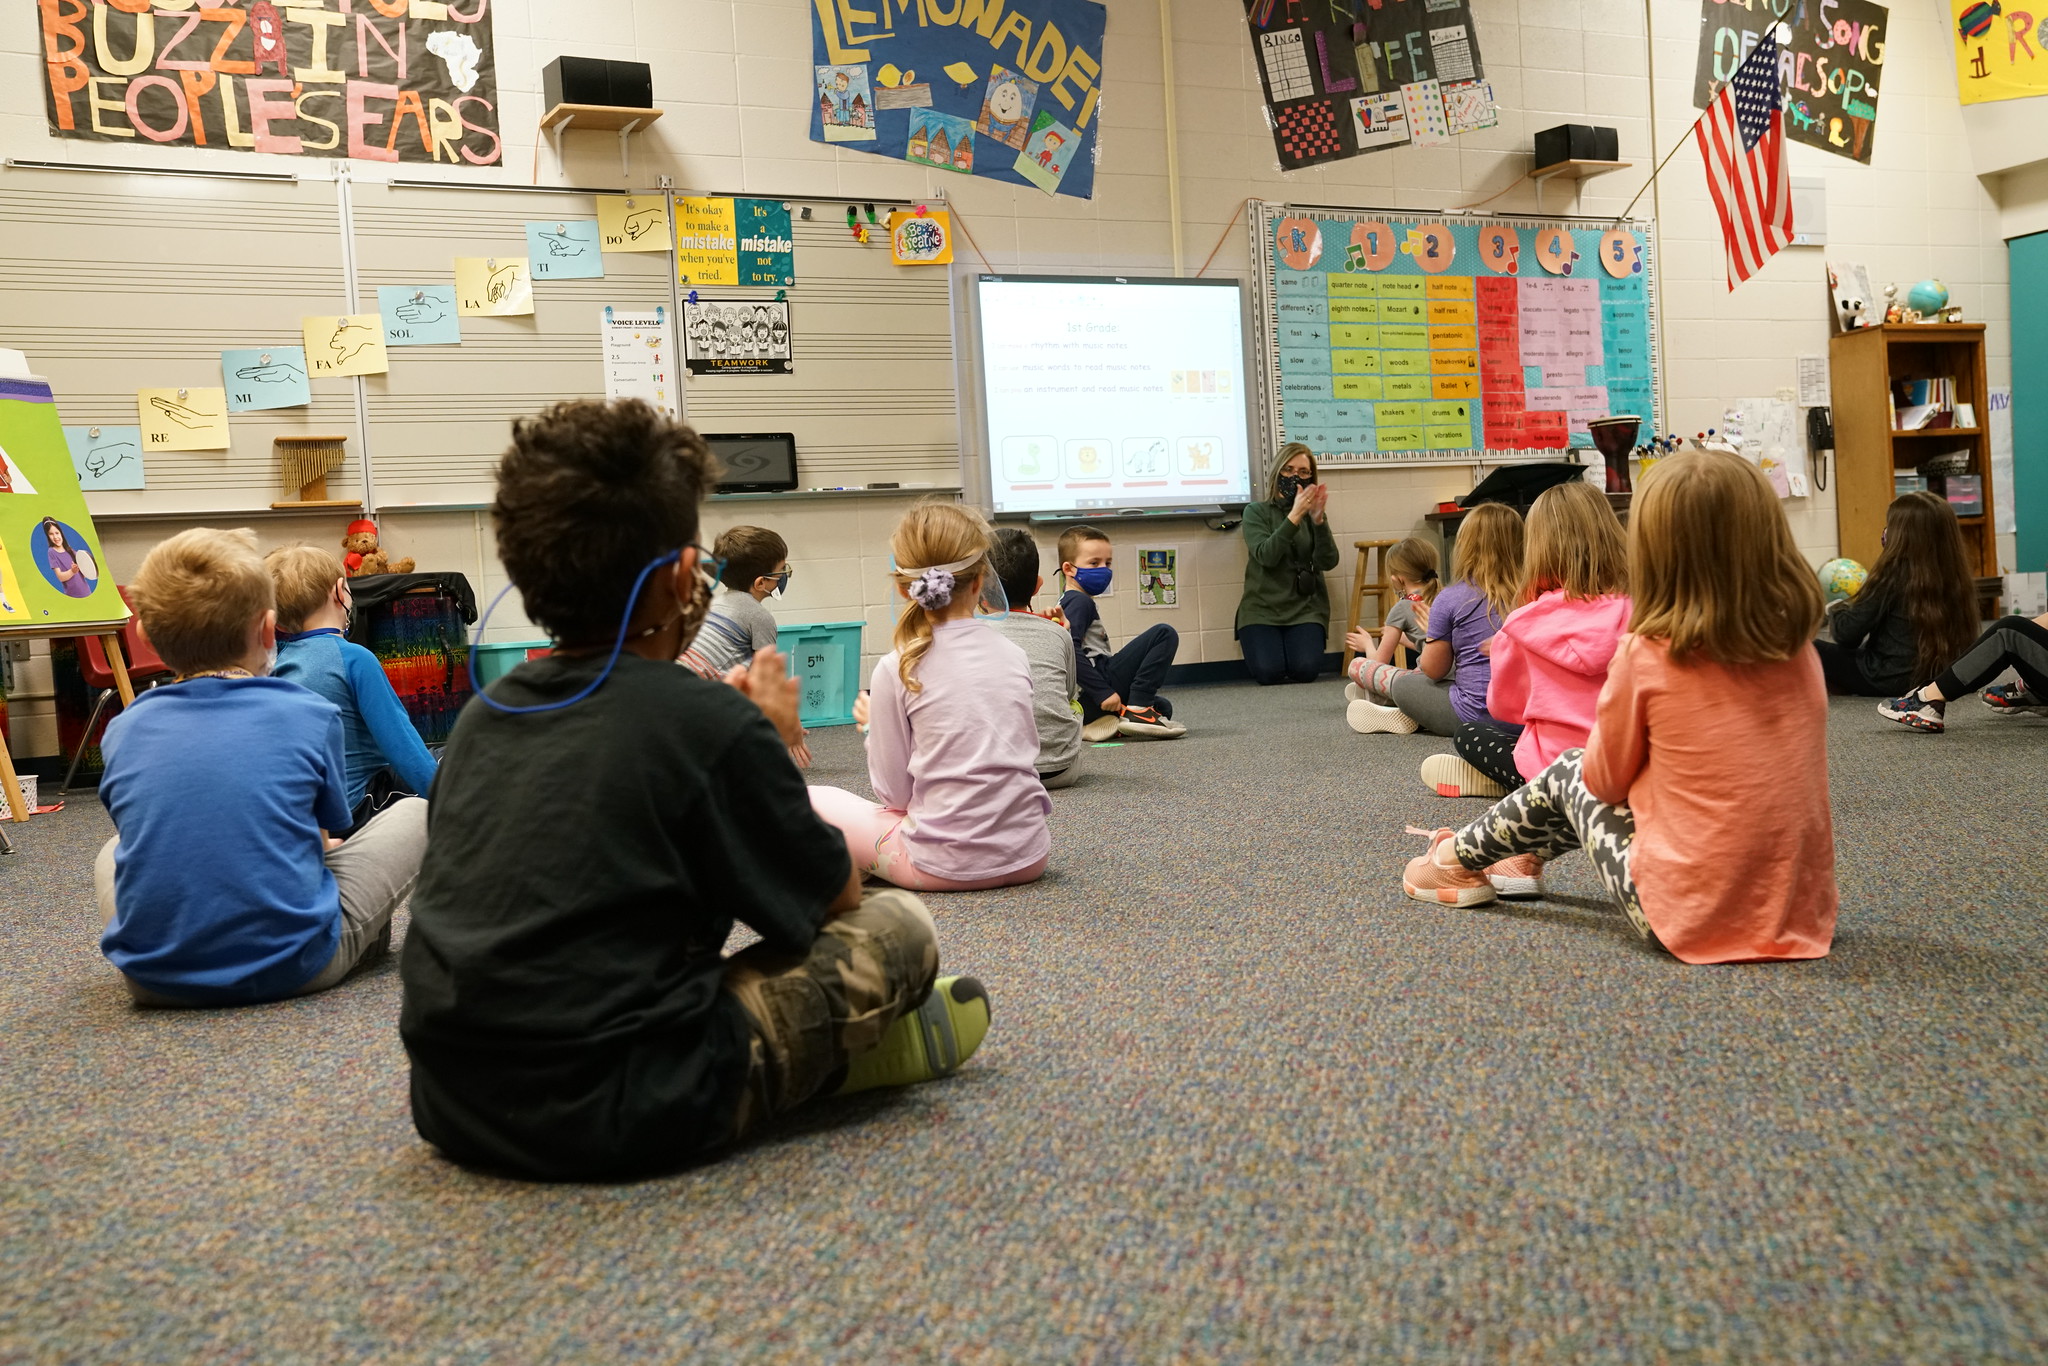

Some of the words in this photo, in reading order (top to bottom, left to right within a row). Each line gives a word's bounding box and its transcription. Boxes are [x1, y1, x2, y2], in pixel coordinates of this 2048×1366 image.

[43, 0, 256, 75] BUZZ
[286, 7, 407, 83] IN
[1264, 33, 1301, 47] BINGO
[48, 60, 341, 153] PEOPLE'S
[346, 80, 500, 164] EARS
[686, 204, 700, 214] It's
[702, 204, 724, 217] okay
[753, 206, 767, 217] It's
[686, 221, 695, 230] to
[697, 220, 721, 231] make
[760, 225, 766, 233] a
[907, 224, 922, 237] Be
[681, 233, 735, 251] mistake
[740, 234, 792, 253] mistake
[1291, 228, 1308, 253] K
[1366, 231, 1378, 256] 1
[1426, 234, 1439, 258] 2
[1491, 235, 1505, 258] 3
[1548, 235, 1562, 258] 4
[1612, 240, 1625, 262] 5
[680, 252, 704, 263] when
[707, 253, 735, 266] you've
[757, 257, 772, 266] not
[537, 263, 549, 272] TI
[698, 269, 722, 280] tried.
[752, 272, 761, 281] to
[763, 272, 778, 284] try.
[464, 299, 481, 310] LA
[1280, 304, 1306, 312] different
[1387, 305, 1407, 313] Mozart
[389, 328, 414, 339] SOL
[1432, 332, 1463, 340] pentatonic
[316, 359, 332, 370] FA
[710, 359, 769, 367] TEAMWORK
[235, 393, 252, 404] MI
[1294, 411, 1309, 419] high
[150, 433, 170, 444] RE
[1433, 431, 1463, 439] vibrations
[807, 653, 825, 668] 5th
